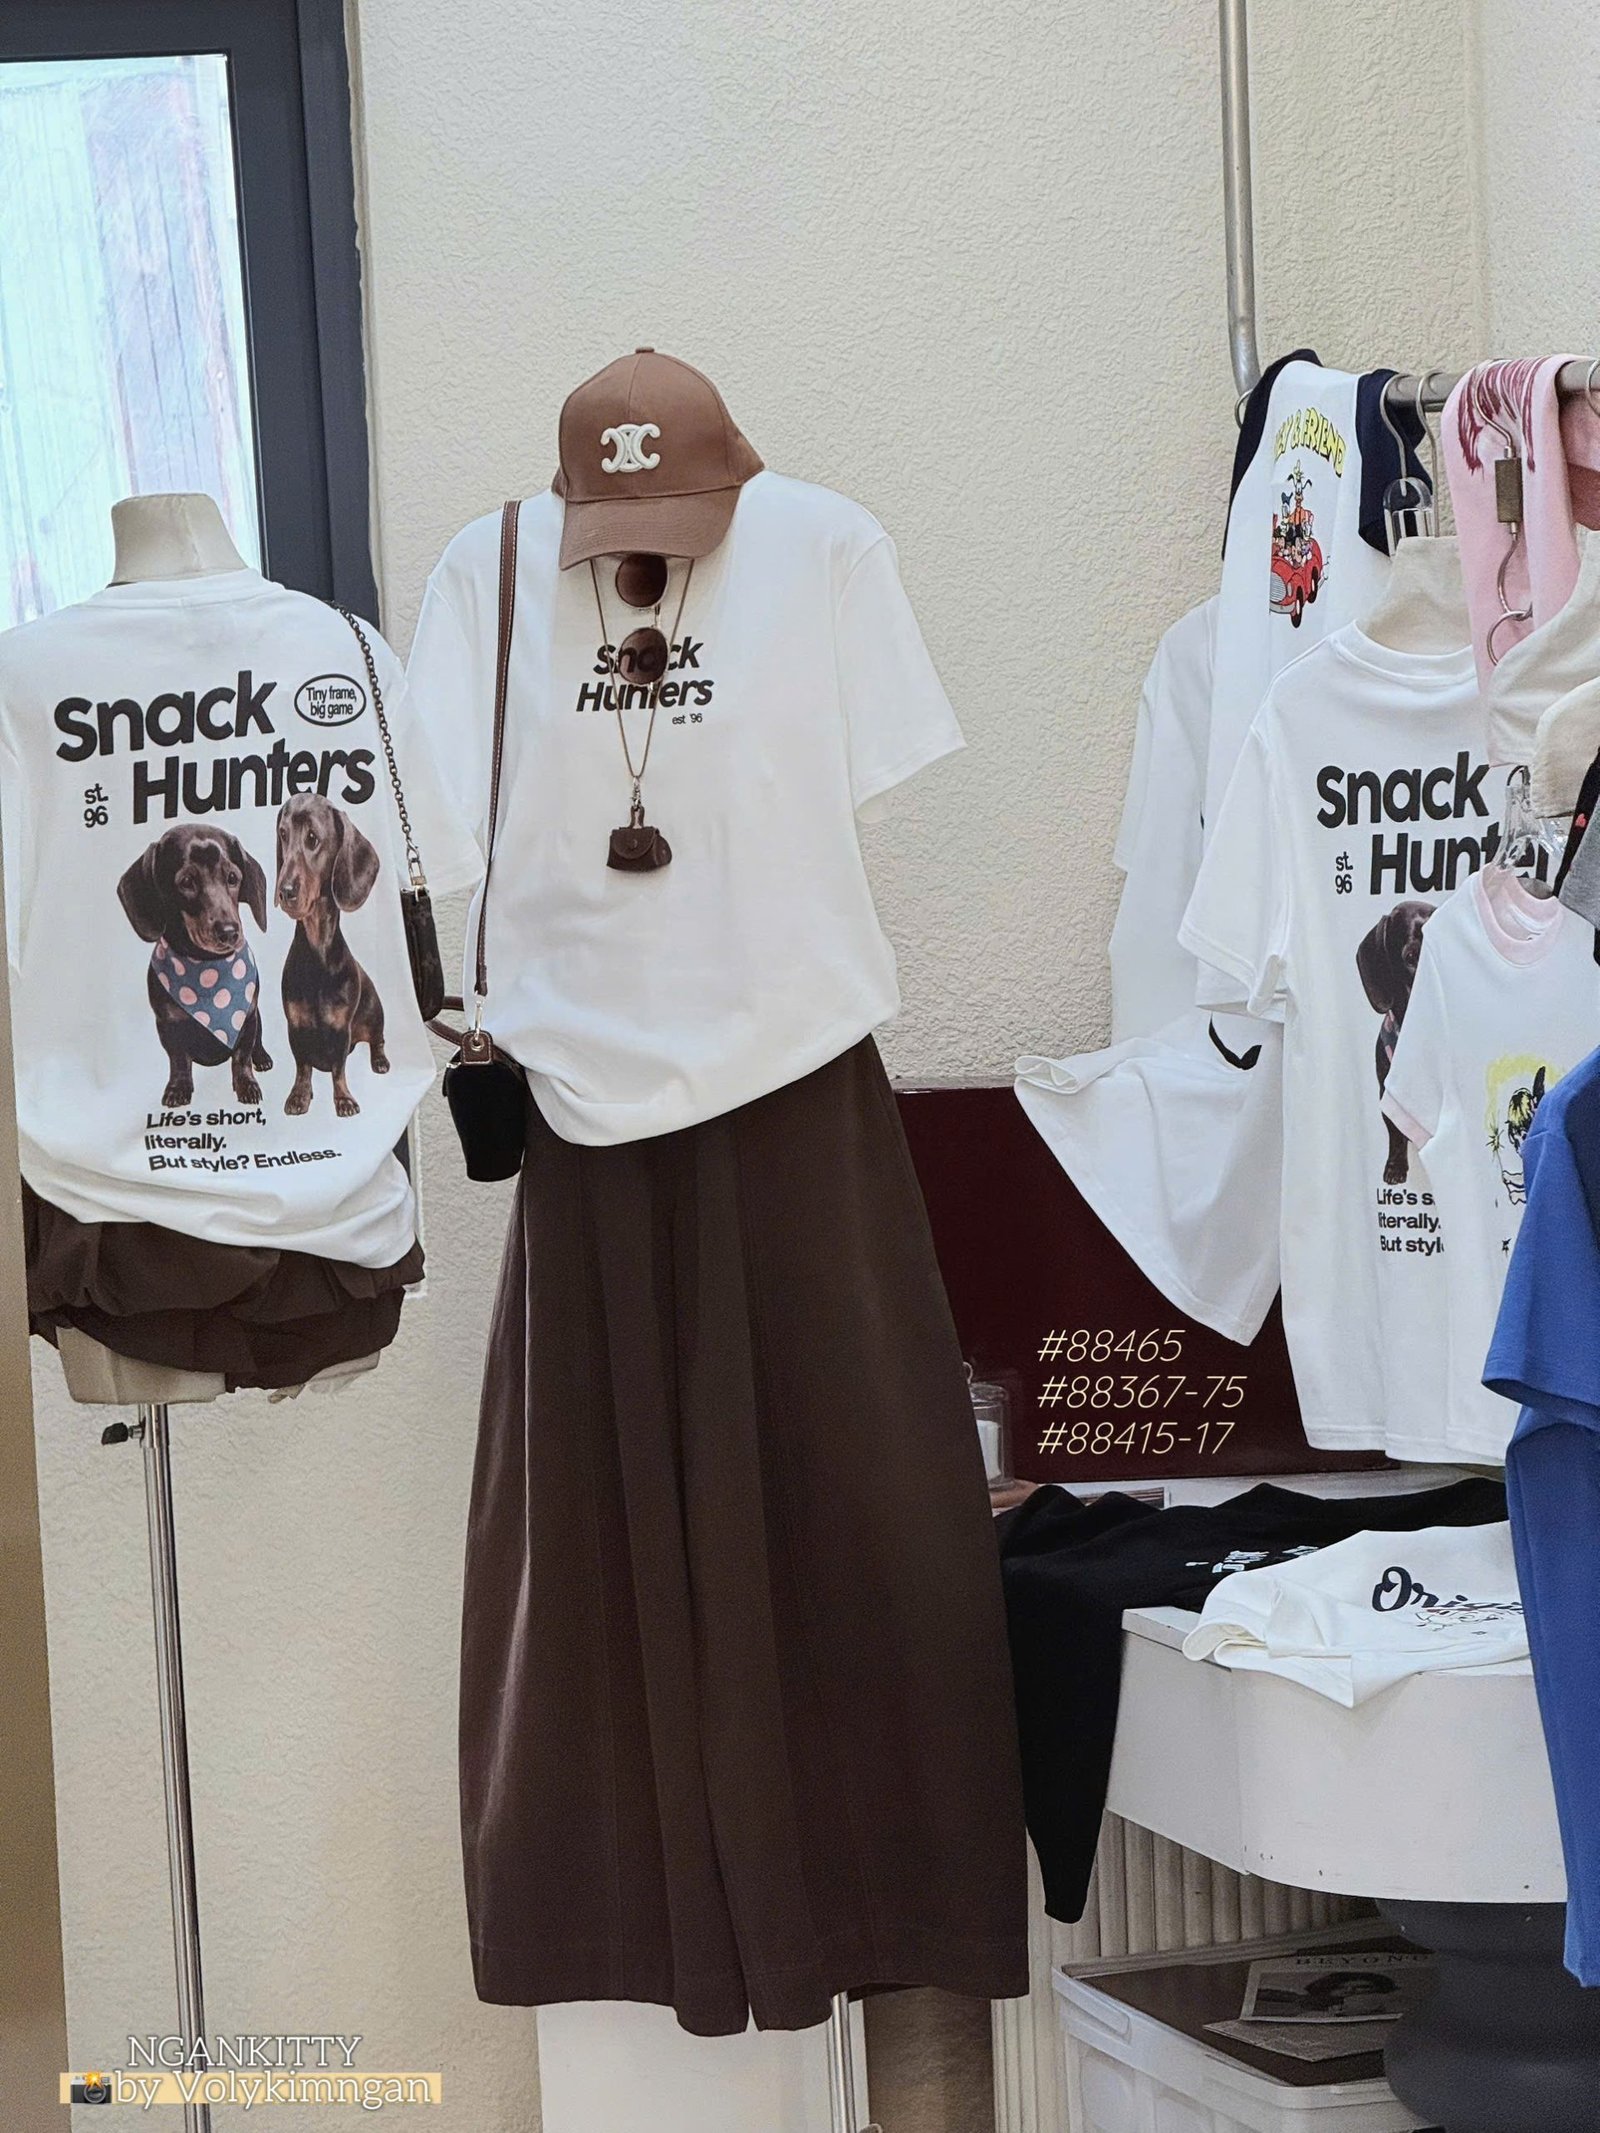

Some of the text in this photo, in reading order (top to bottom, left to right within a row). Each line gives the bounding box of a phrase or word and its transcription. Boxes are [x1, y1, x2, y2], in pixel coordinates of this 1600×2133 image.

[305, 685, 357, 703] Tiny frame,
[54, 670, 277, 762] Snack
[310, 702, 353, 718] big game
[672, 714, 686, 725] est
[133, 738, 376, 824] Hunters
[1316, 751, 1490, 829] Snack
[84, 805, 109, 828] 96
[1335, 874, 1353, 894] 96
[146, 1107, 267, 1129] Life's short,
[144, 1133, 227, 1153] literally.
[149, 1149, 342, 1173] But style? Endless.
[1376, 1188, 1418, 1206] Life's
[1380, 1235, 1444, 1257] But styl
[1296, 1953, 1429, 1966] BEYONC
